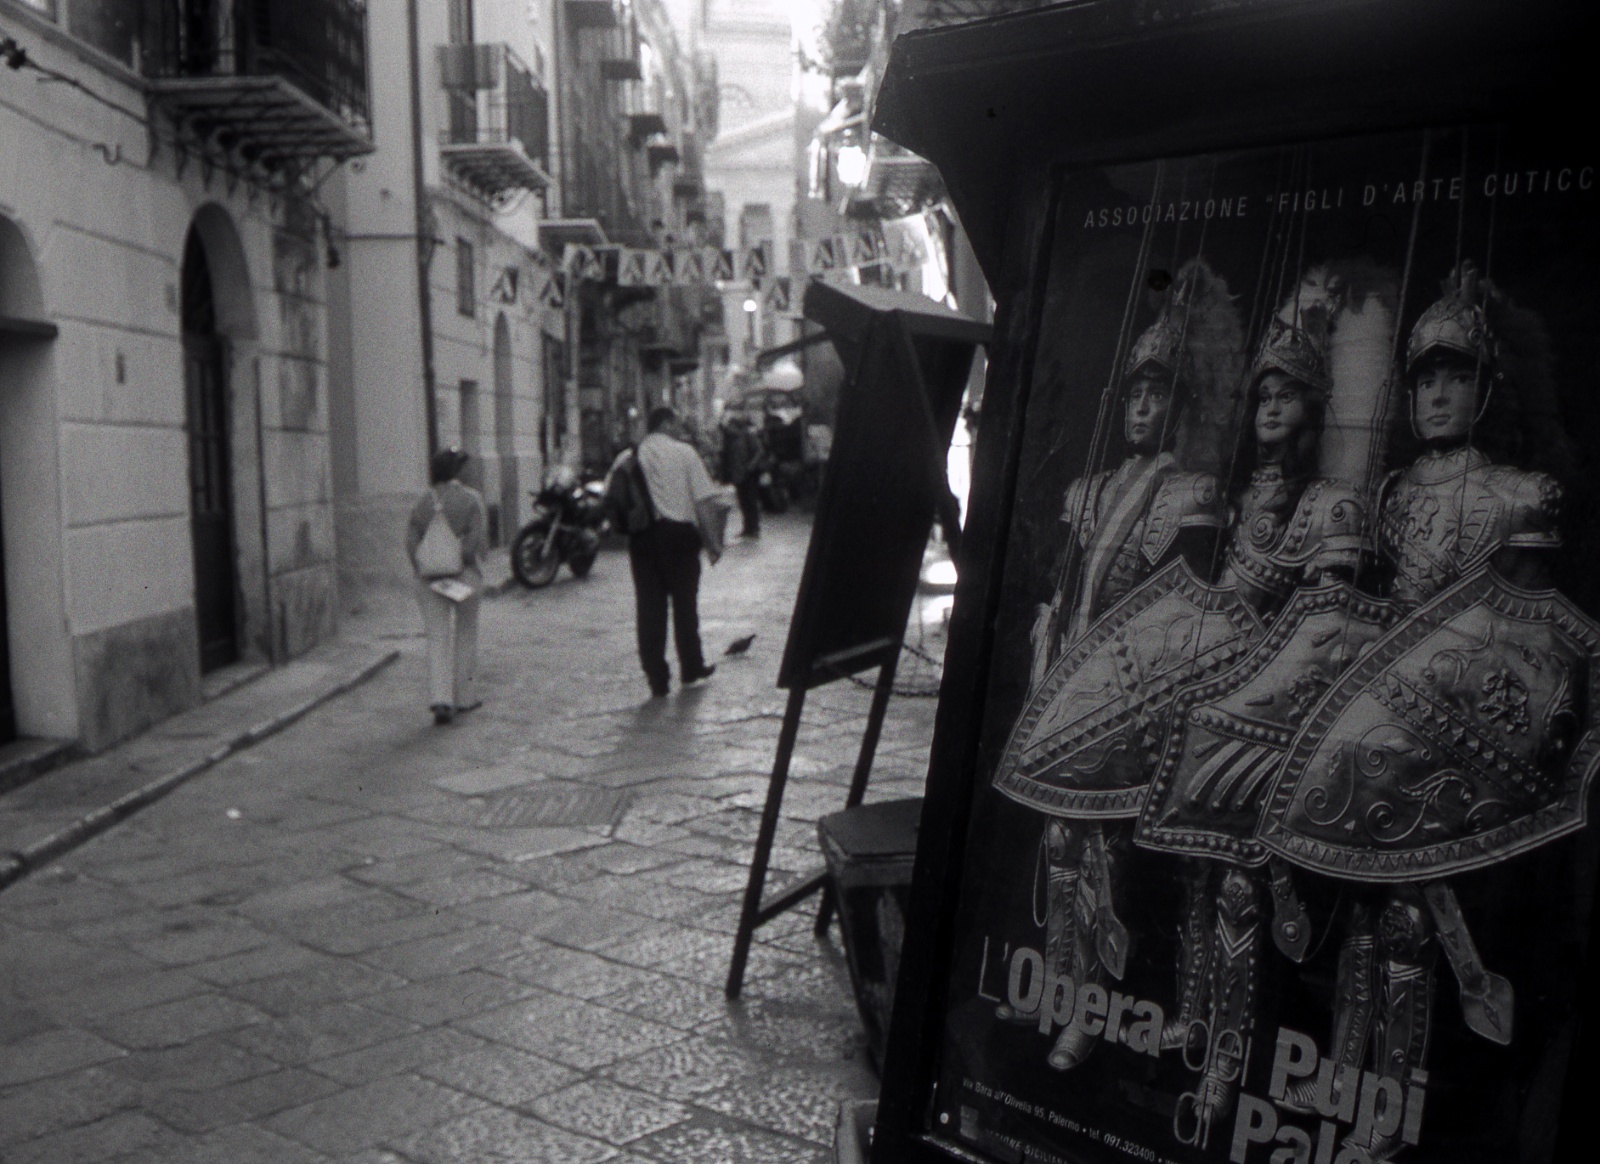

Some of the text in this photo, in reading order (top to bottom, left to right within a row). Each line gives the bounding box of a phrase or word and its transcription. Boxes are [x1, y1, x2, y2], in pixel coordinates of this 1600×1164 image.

[1083, 195, 1249, 229] ASSOCIAZIONE
[1362, 176, 1462, 206] D'ARTE
[1181, 1005, 1256, 1088] dei
[1267, 1026, 1430, 1149] Pupi
[1048, 1110, 1081, 1133] Palermo
[1103, 1131, 1155, 1162] 091.323400
